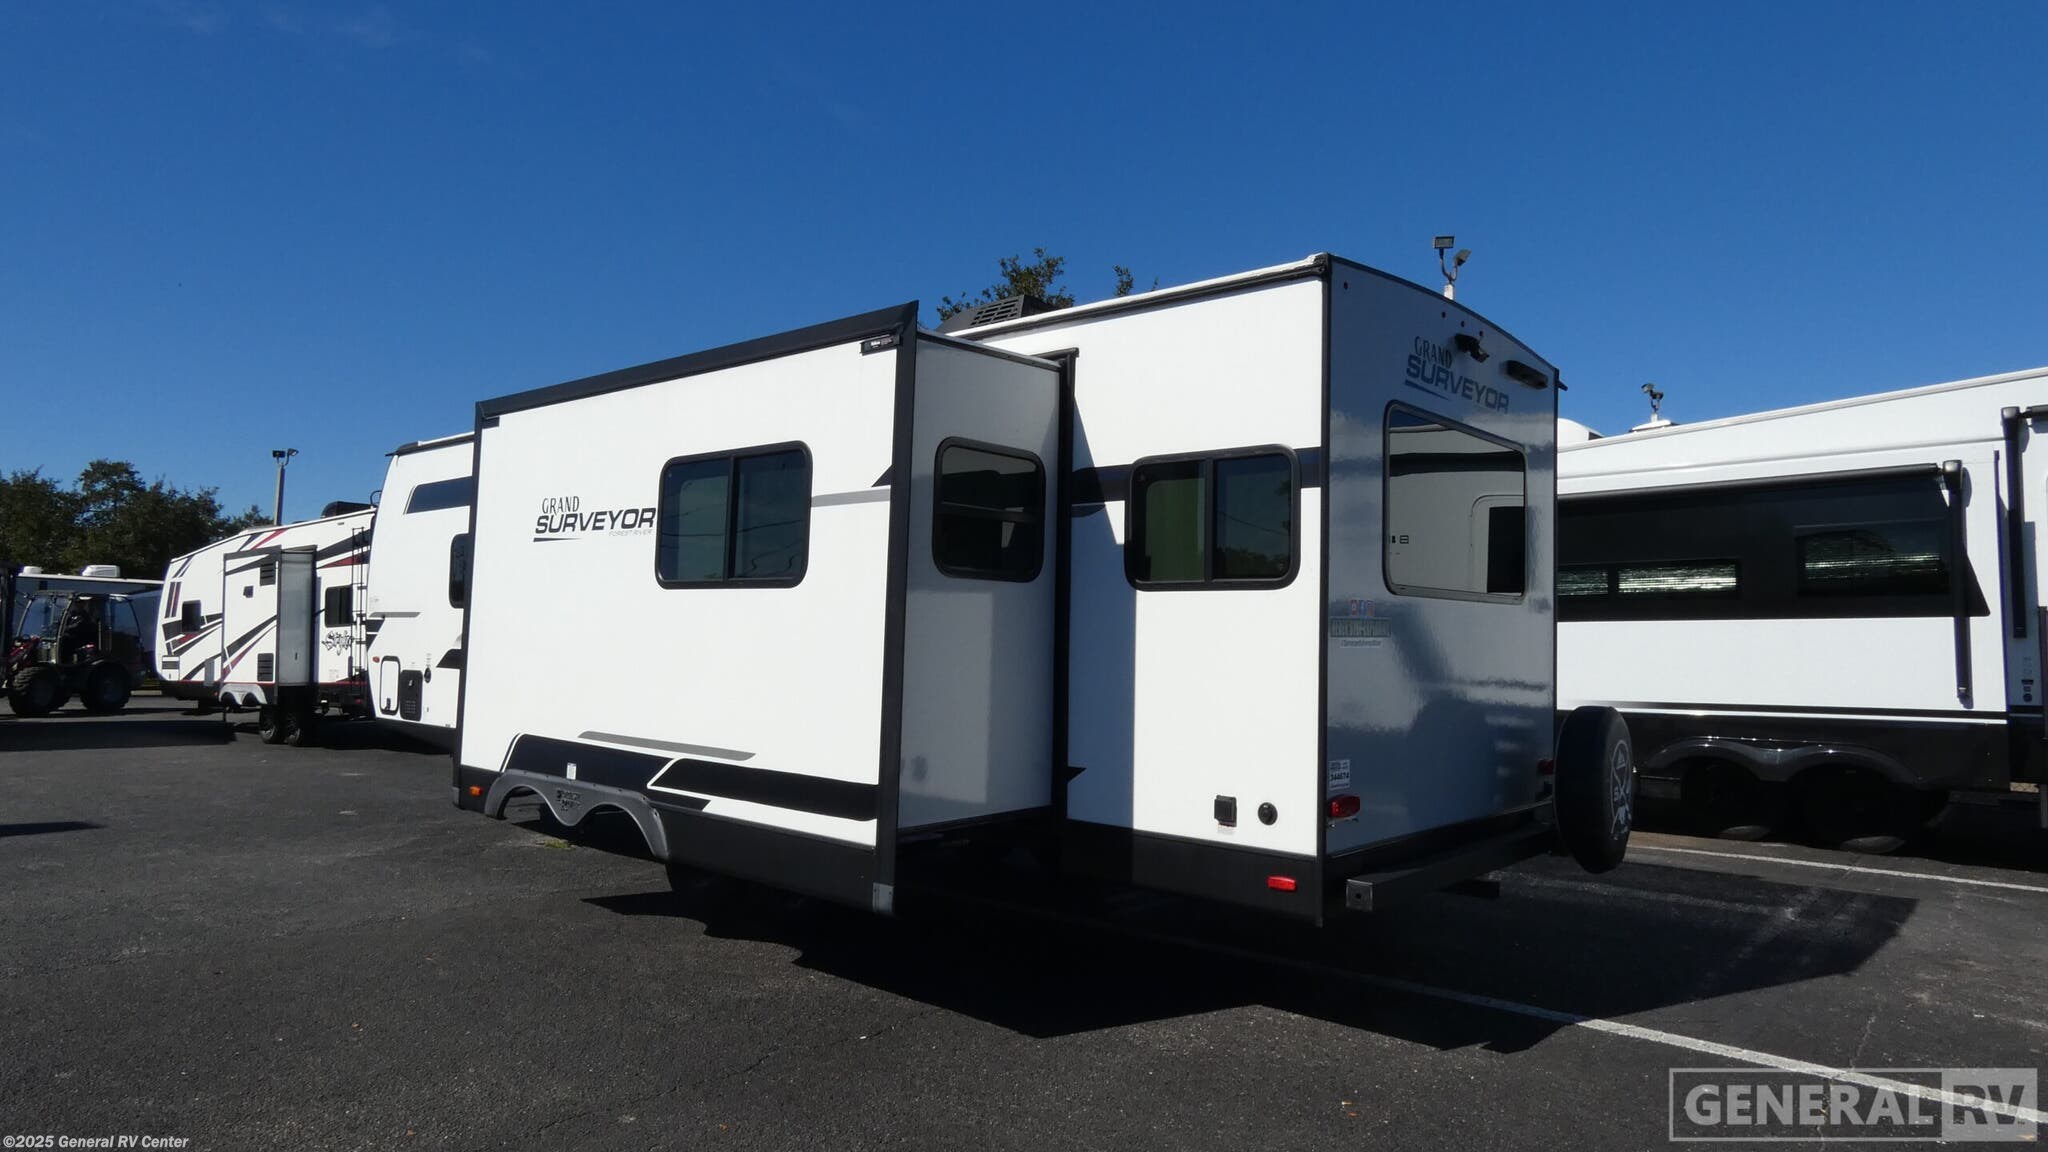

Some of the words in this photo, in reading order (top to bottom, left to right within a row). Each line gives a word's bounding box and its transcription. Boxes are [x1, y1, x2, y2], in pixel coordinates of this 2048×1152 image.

[1414, 335, 1453, 369] GRAND
[1405, 354, 1510, 415] SURVEYOR
[541, 495, 581, 515] GRAND
[535, 507, 657, 534] SURVEYOR
